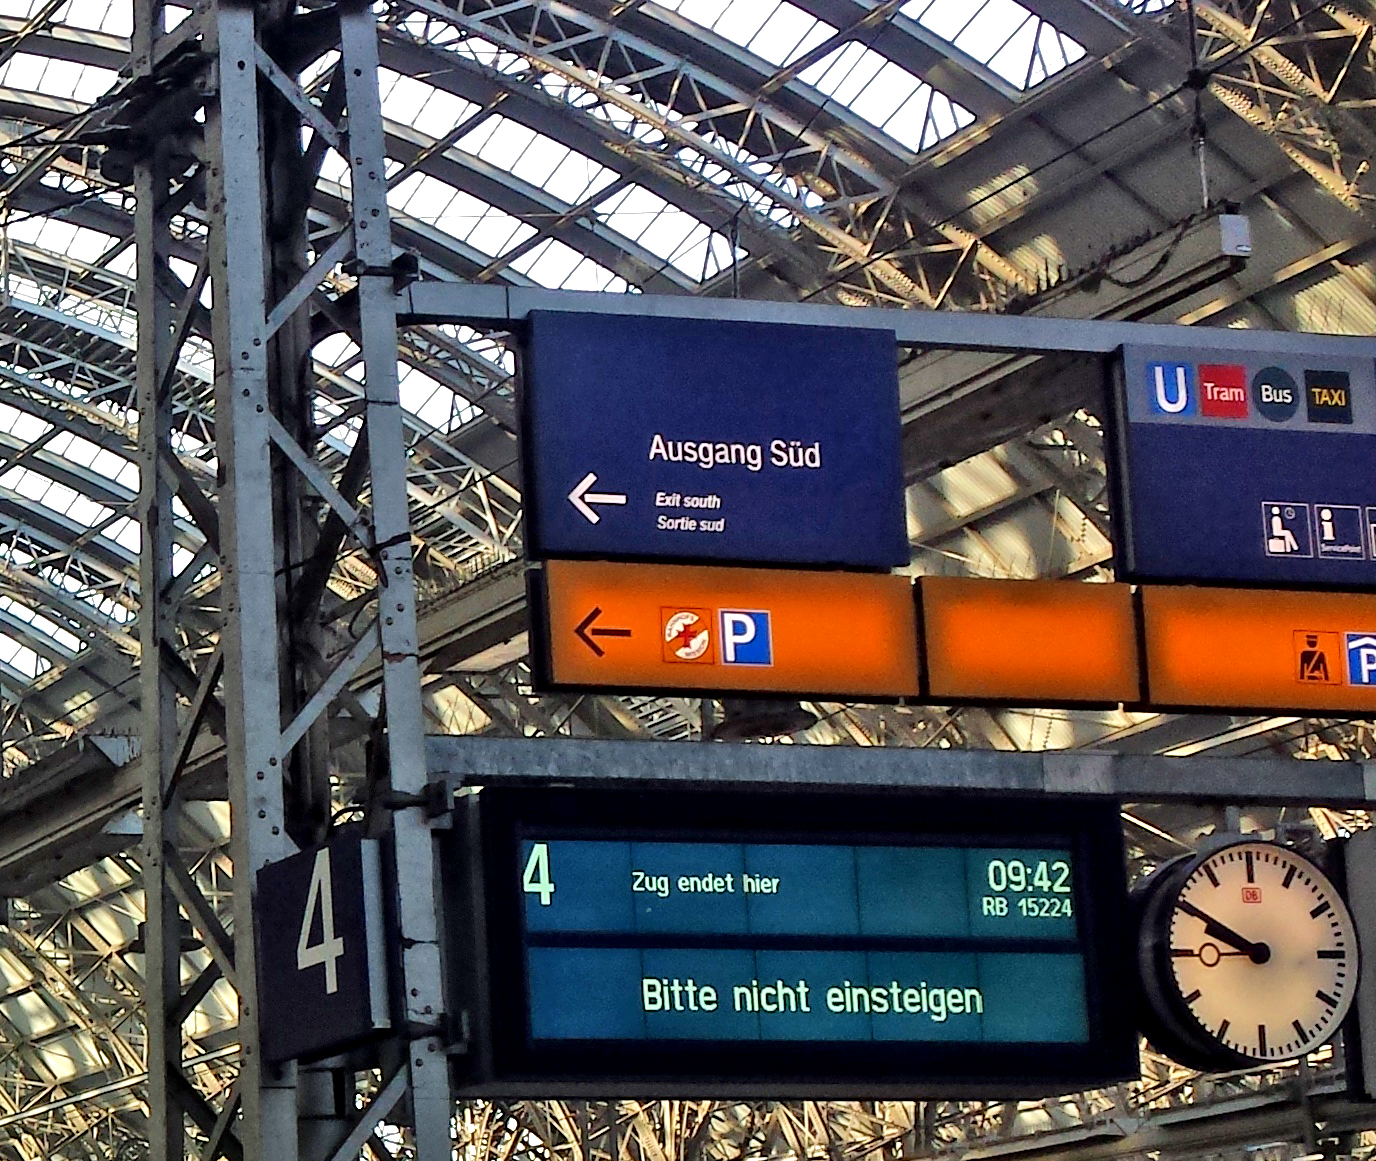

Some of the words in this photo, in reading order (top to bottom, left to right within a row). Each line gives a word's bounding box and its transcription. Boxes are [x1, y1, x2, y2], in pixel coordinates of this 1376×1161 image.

[1154, 366, 1187, 413] U
[1204, 383, 1245, 402] Tram
[1261, 385, 1293, 404] Bus
[1311, 388, 1346, 407] TAXI
[649, 434, 762, 471] Ausgang
[770, 440, 821, 467] Süd
[656, 492, 681, 507] Exit
[683, 494, 721, 509] south
[657, 516, 697, 531] Sortie
[699, 518, 725, 532] sud
[723, 612, 756, 662] P
[523, 843, 555, 906] 4
[632, 871, 670, 897] Zug
[678, 873, 734, 893] endet
[742, 874, 780, 894] hier
[988, 860, 1071, 893] 09:42
[297, 847, 345, 995] 4
[982, 897, 1009, 916] RB
[1017, 898, 1073, 917] 15224
[643, 977, 718, 1011] Bitte
[733, 979, 810, 1013] nicht
[826, 983, 983, 1021] einsteigen
